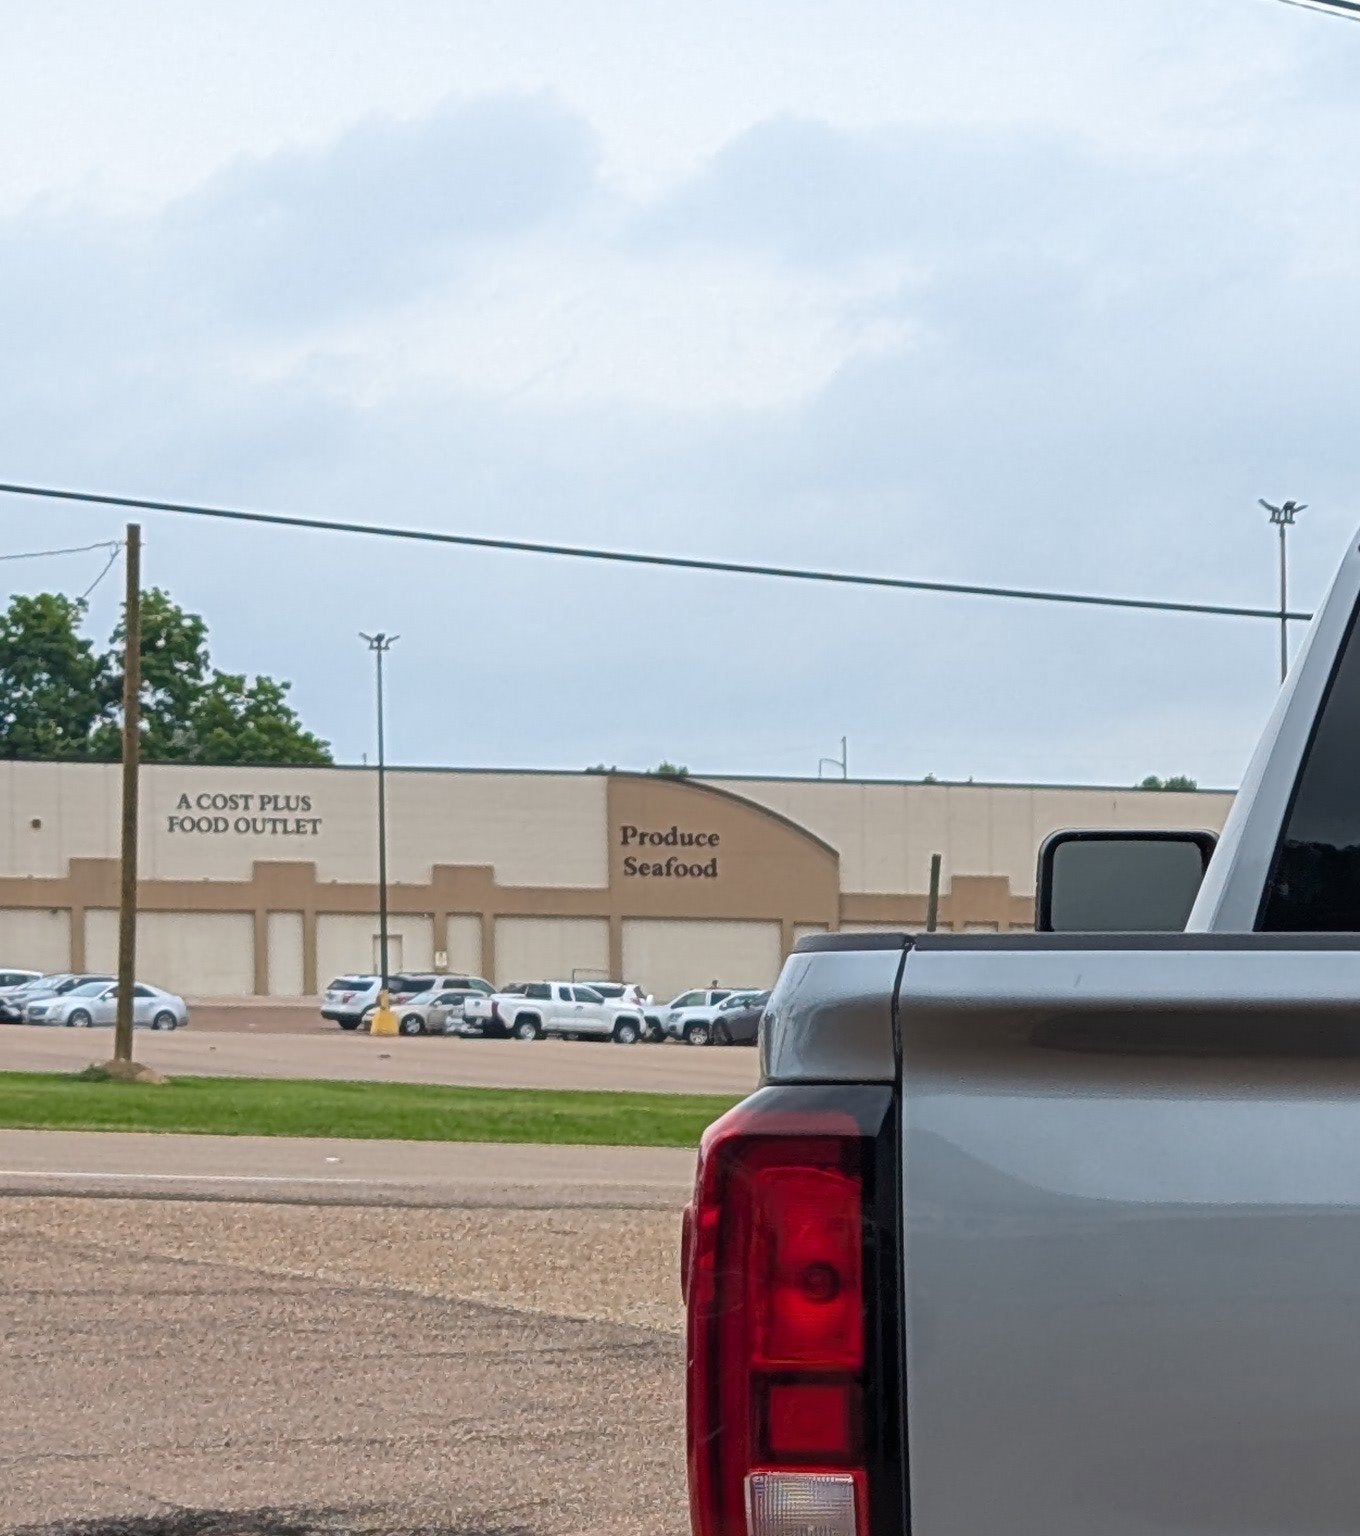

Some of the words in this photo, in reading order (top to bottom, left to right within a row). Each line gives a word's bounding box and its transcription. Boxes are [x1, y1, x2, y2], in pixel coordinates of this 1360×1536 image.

[177, 793, 192, 809] A
[196, 793, 254, 811] COST
[259, 794, 312, 812] PLUS
[167, 815, 230, 833] FOOD
[233, 816, 322, 835] OUTLET
[620, 825, 720, 847] Produce
[623, 856, 718, 877] Seafood
